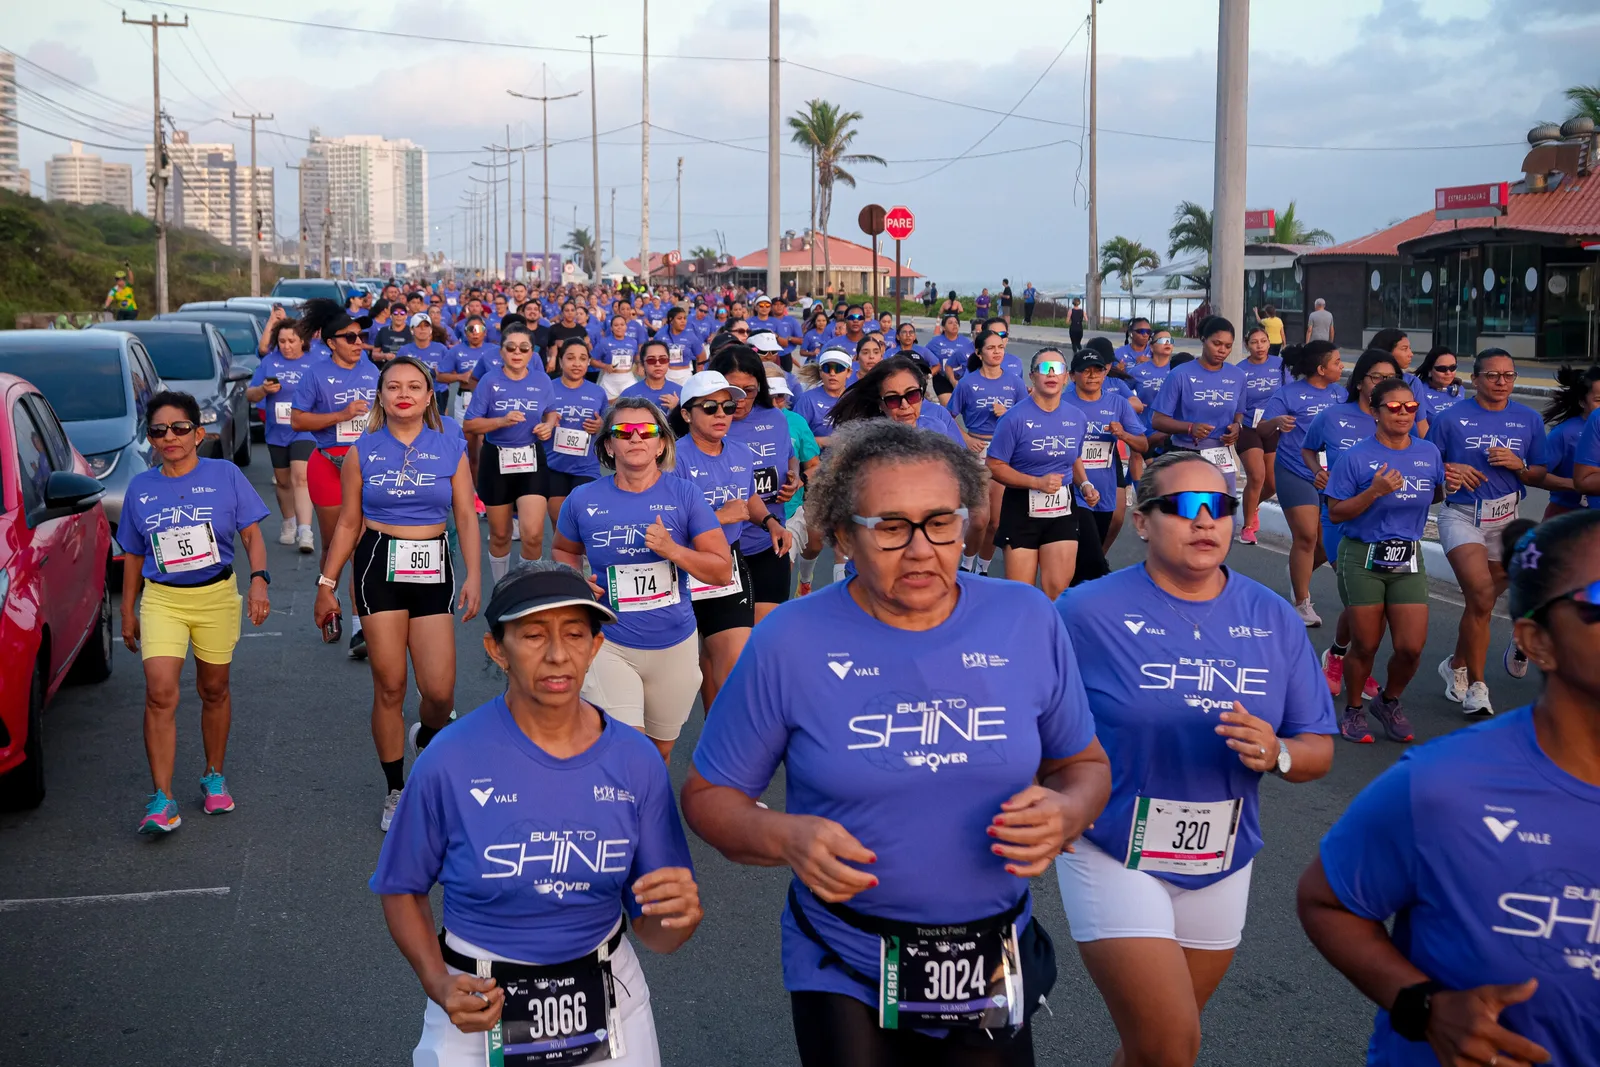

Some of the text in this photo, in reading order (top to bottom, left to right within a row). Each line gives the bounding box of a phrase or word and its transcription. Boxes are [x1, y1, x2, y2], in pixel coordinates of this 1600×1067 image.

[887, 218, 913, 228] PARE
[334, 389, 376, 404] SHINE
[1194, 392, 1233, 400] SHINE
[495, 401, 538, 411] SHINE
[566, 435, 579, 447] 992
[1031, 438, 1075, 451] SHINE
[1465, 437, 1522, 450] SHINE
[513, 451, 527, 464] 624
[1086, 448, 1102, 459] 1004
[369, 473, 437, 487] SHINE
[1045, 493, 1061, 507] 274
[1491, 503, 1510, 518] 1429
[145, 507, 213, 531] SHINE
[177, 538, 194, 557] 55
[1383, 546, 1407, 562] 3027
[410, 551, 430, 569] 950
[634, 575, 657, 595] 174
[1145, 627, 1166, 635] VALE
[1179, 657, 1236, 667] BUILT TO
[854, 667, 880, 676] VALE
[1139, 663, 1269, 695] SHINE
[897, 698, 967, 714] BUILT TO
[848, 706, 1007, 750] SHINE
[494, 793, 518, 803] VALE
[530, 830, 596, 842] BUILT TO
[1133, 819, 1147, 853] VERDE
[1172, 820, 1210, 850] 320
[1517, 831, 1551, 845] VALE
[482, 839, 629, 878] SHINE
[916, 926, 967, 936] Track & Field
[887, 963, 898, 1005] VERDE
[924, 955, 986, 1000] 3024
[528, 991, 587, 1039] 3066
